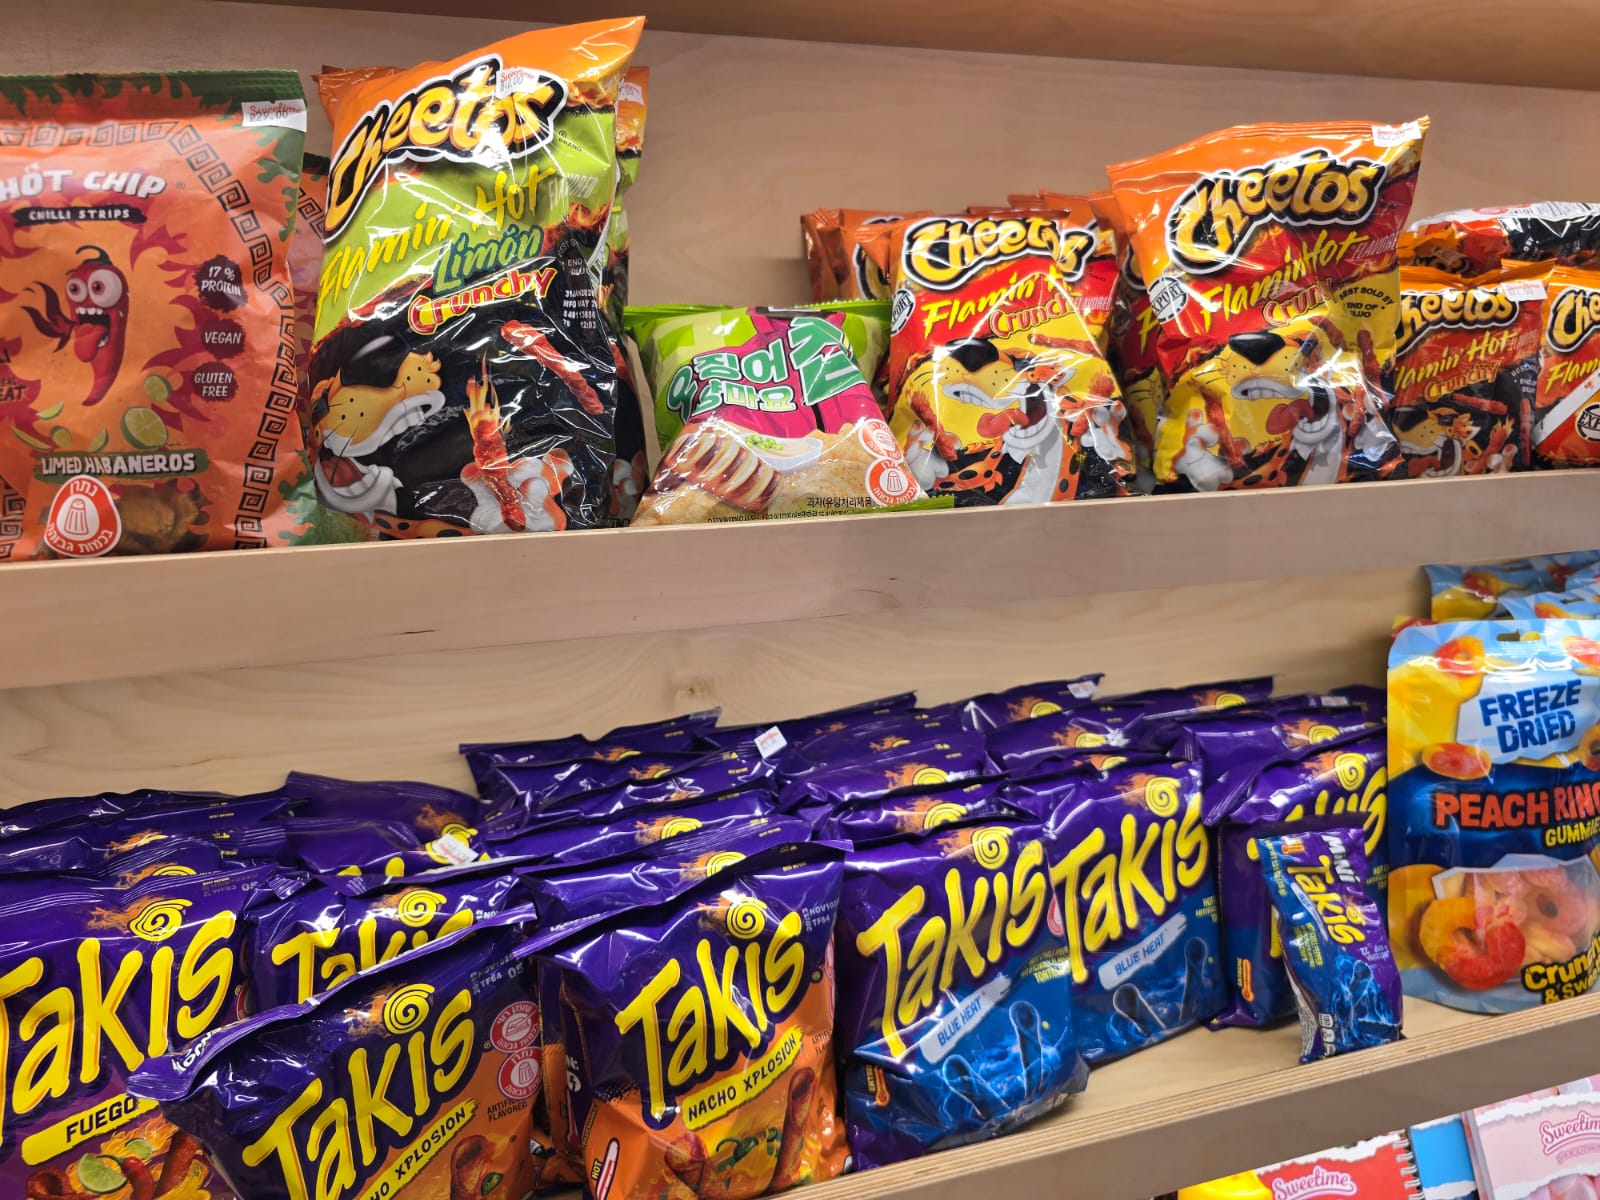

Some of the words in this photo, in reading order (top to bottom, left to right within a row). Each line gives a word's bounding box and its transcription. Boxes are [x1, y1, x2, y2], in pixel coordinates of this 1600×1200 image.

[325, 62, 558, 232] Cheetos
[83, 169, 167, 199] CHIP
[29, 209, 71, 221] CHILLI
[78, 207, 130, 220] STRIPS
[1176, 153, 1385, 264] Cheetos
[433, 224, 543, 296] Limón
[1304, 229, 1369, 271] Hot
[1350, 231, 1399, 261] FLAVORE
[201, 279, 242, 296] PROTEIN
[208, 265, 222, 278] 17
[224, 267, 235, 281] %
[407, 267, 557, 335] Crunchy
[1360, 287, 1384, 299] SOLD
[1364, 303, 1379, 311] OF
[204, 330, 242, 345] VEGAN
[1466, 330, 1518, 362] Hot
[194, 372, 233, 384] GLUTEN
[202, 385, 229, 397] FREE
[41, 456, 82, 475] LIMED
[85, 452, 196, 474] HABANEROS
[69, 480, 99, 497] נתרן
[77, 529, 114, 553] בכמות
[1479, 679, 1583, 727] FREEZE
[1497, 710, 1577, 754] DRIED
[1434, 791, 1550, 828] PEACH
[1050, 789, 1209, 984] Takis
[1286, 855, 1366, 944] Takis
[855, 838, 1047, 1059] Takis
[1114, 953, 1141, 977] BLUE
[1142, 934, 1166, 962] HEAT
[614, 910, 805, 1122] Takis
[936, 1020, 961, 1048] BLUE
[959, 995, 984, 1027] HEAT
[243, 988, 474, 1200] Takis
[687, 1089, 738, 1123] NACHO
[742, 1033, 798, 1092] XPLOSION
[65, 1095, 139, 1143] FUEGO
[488, 1100, 528, 1122] FLAVORED
[394, 1108, 467, 1181] XPLOSION
[591, 1159, 603, 1180] HOT
[1273, 1167, 1348, 1200] Sweetime
